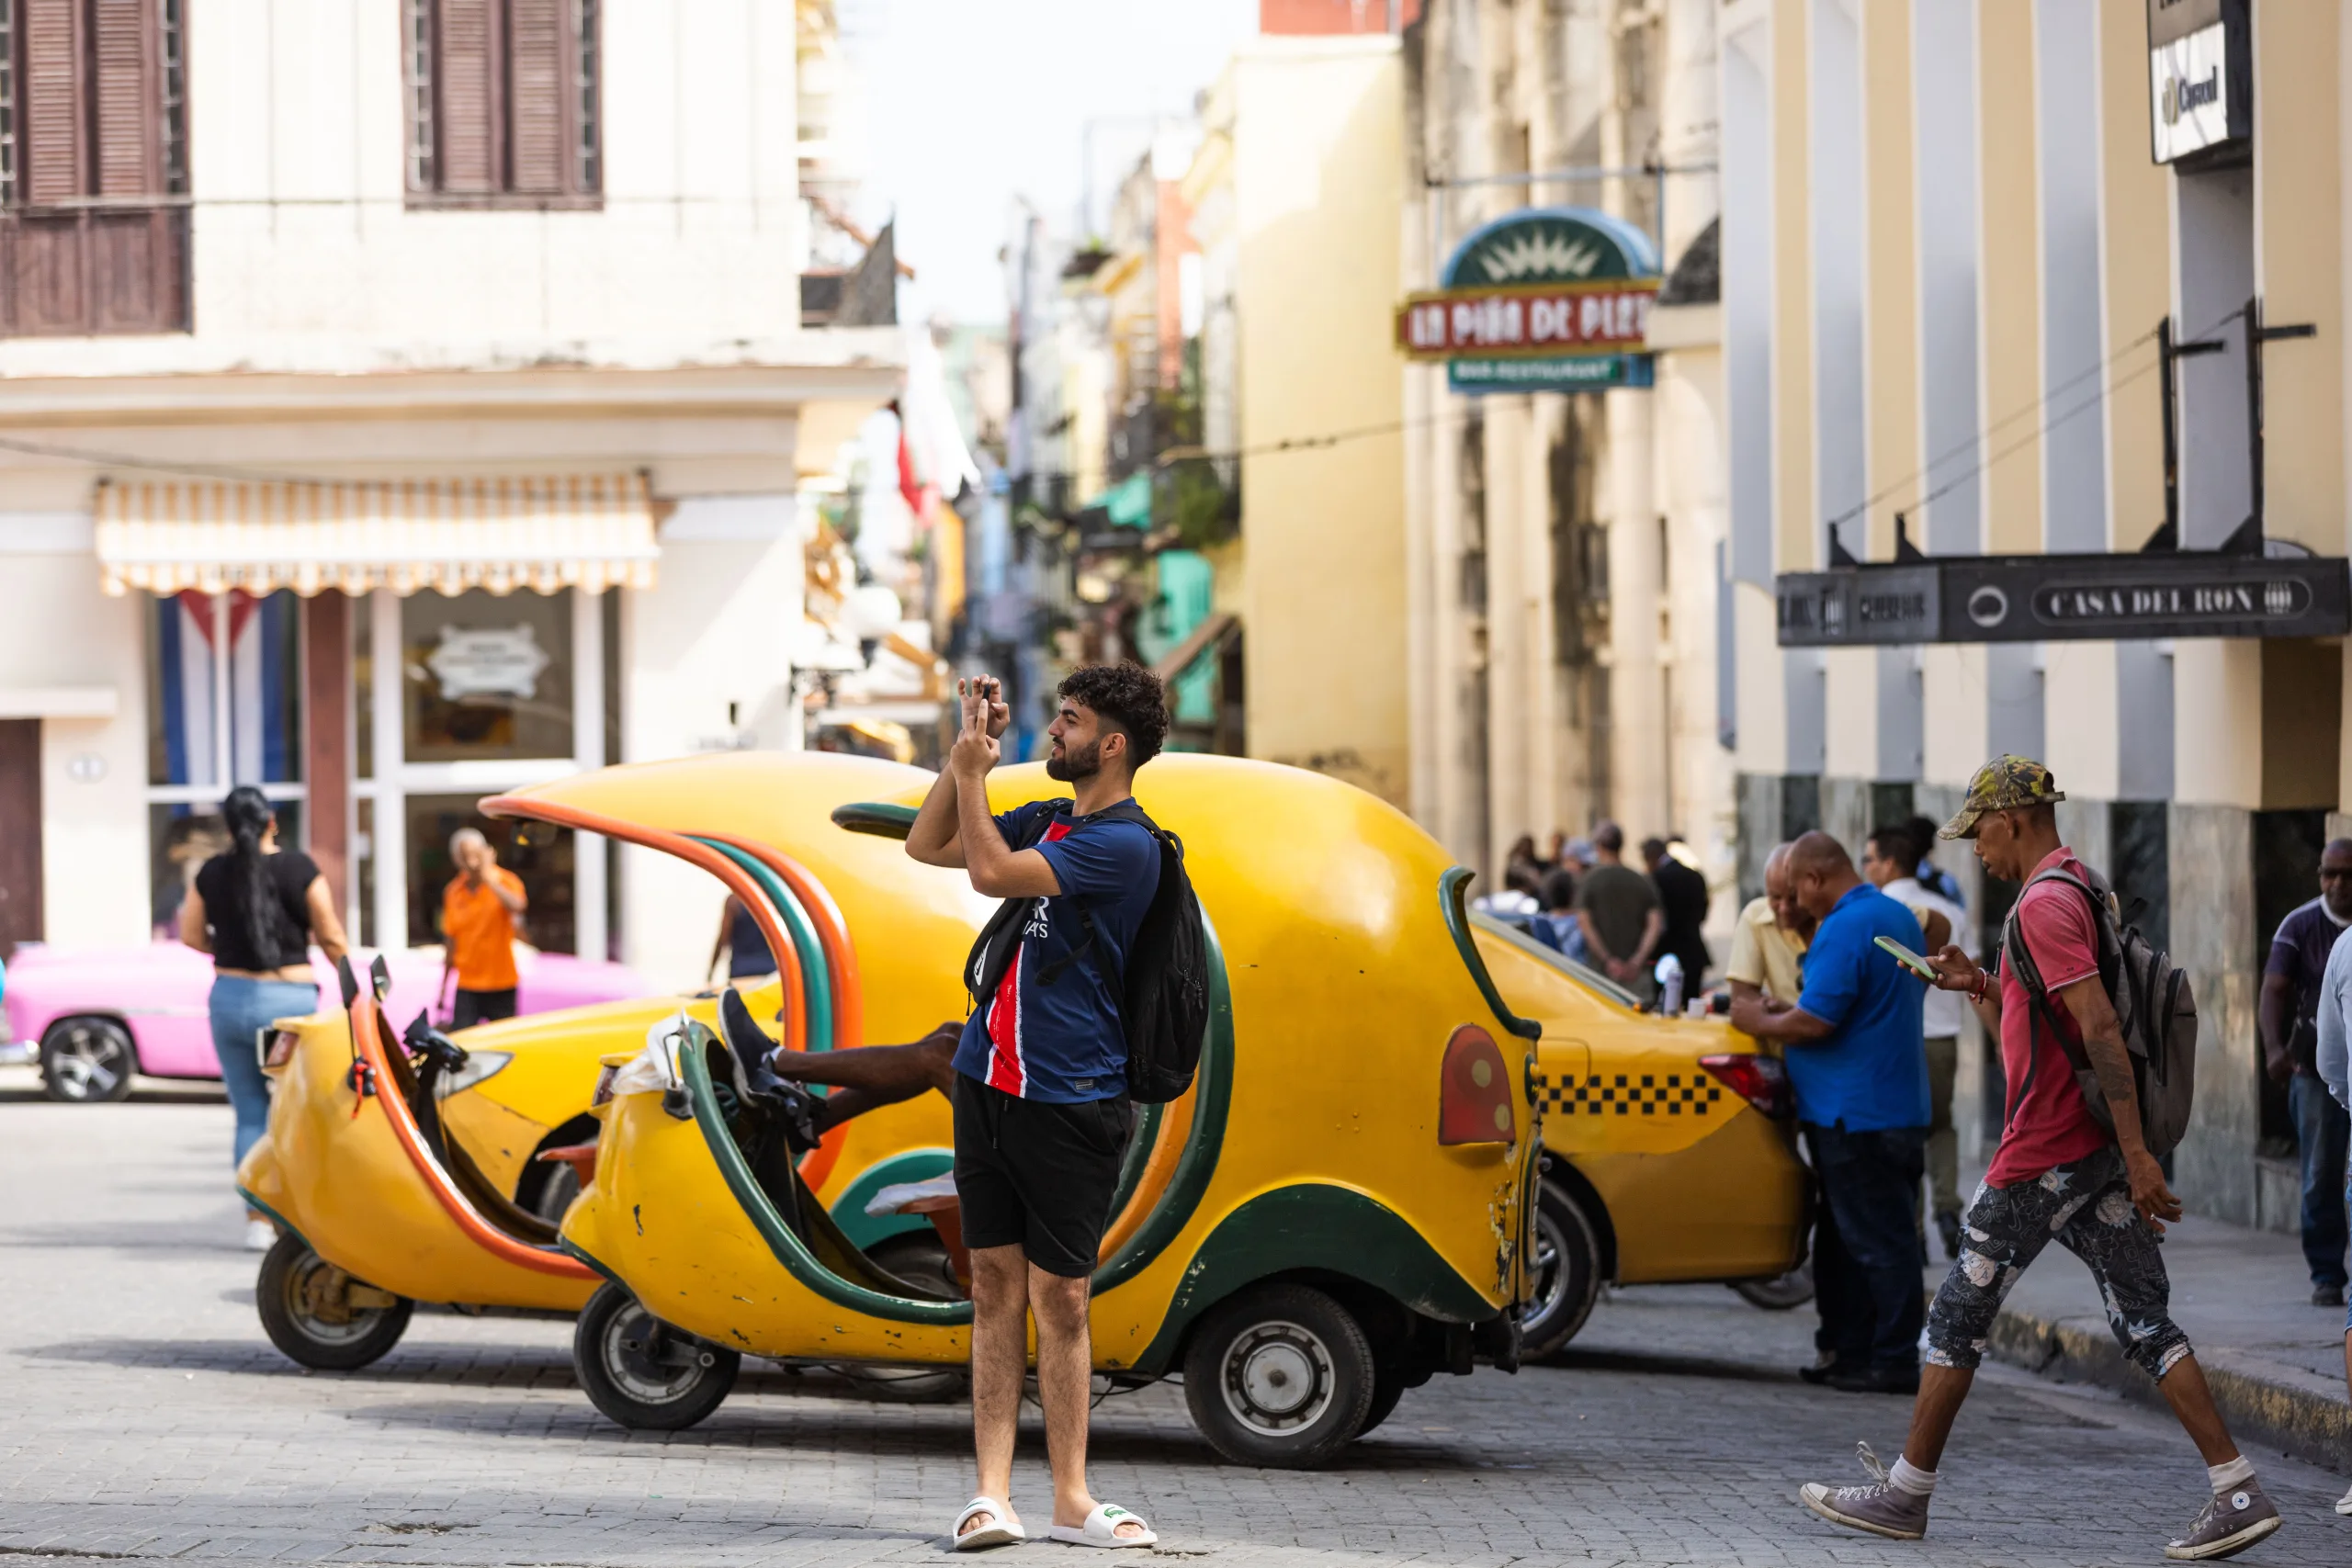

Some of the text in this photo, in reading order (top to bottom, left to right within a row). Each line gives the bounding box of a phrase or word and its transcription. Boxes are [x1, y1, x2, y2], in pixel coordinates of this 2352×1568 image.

[1531, 298, 1572, 343] DE
[2050, 586, 2253, 617] CASA DEL RON
